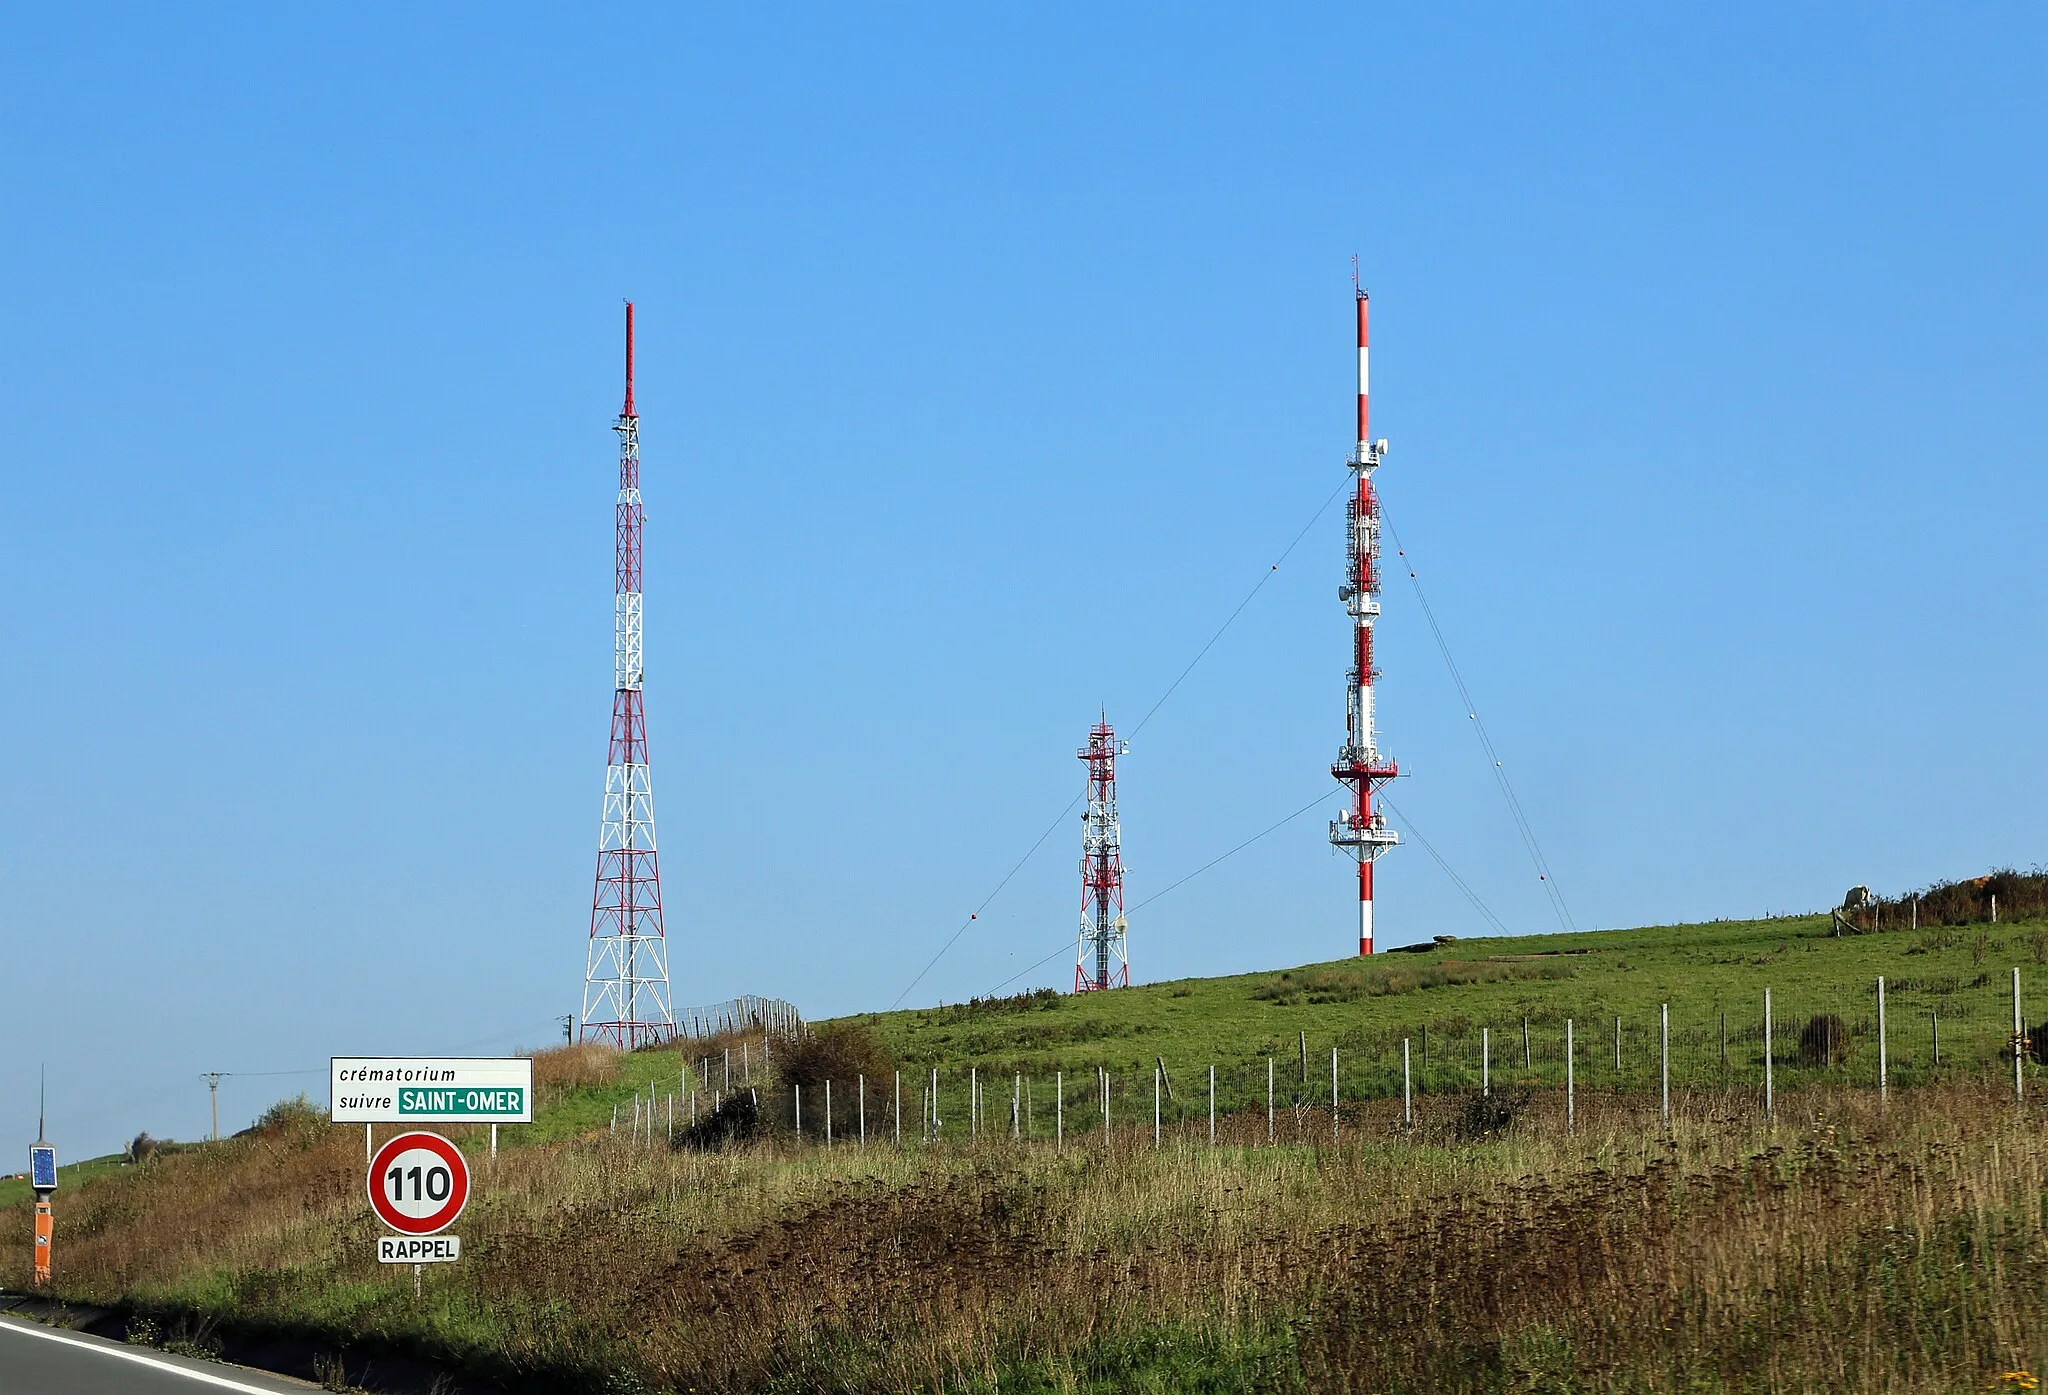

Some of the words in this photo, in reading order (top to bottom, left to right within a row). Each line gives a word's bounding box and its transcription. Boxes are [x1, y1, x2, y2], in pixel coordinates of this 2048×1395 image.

[339, 1066, 455, 1082] crématorium
[339, 1093, 391, 1109] suivre
[402, 1091, 520, 1111] SAINT-OMER
[388, 1166, 450, 1201] 110
[382, 1241, 456, 1258] RAPPEL
